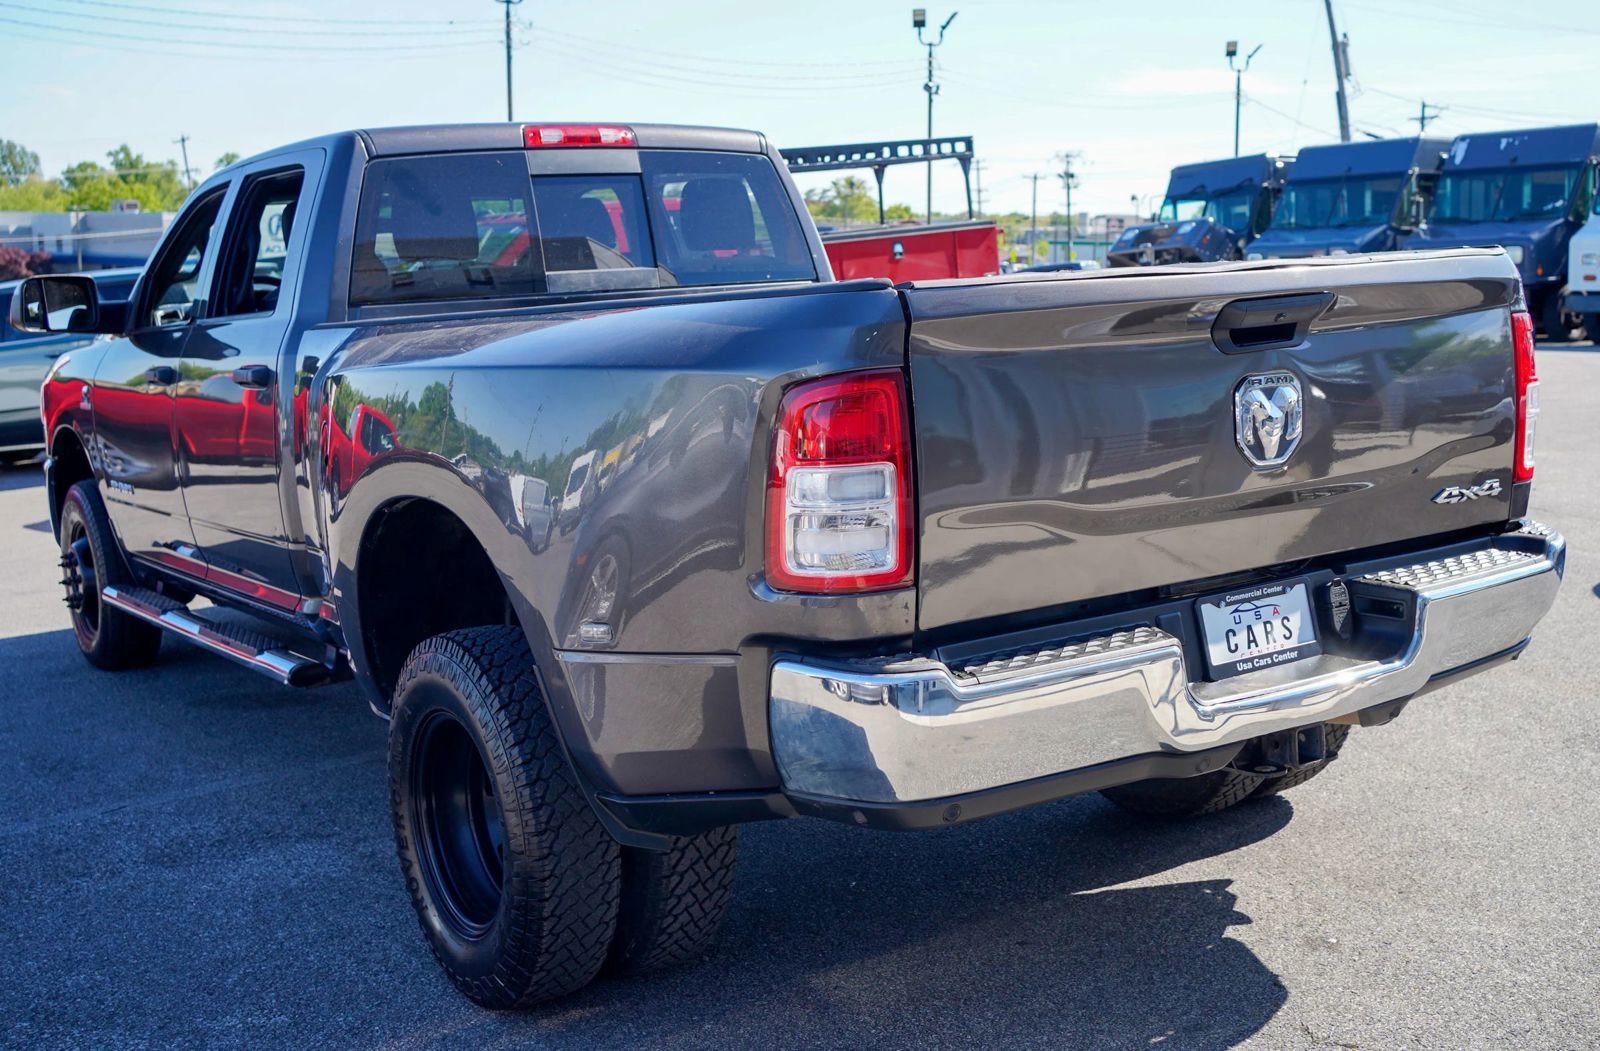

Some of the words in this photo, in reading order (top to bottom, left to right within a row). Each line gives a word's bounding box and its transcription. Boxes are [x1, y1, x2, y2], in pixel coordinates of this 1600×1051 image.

[1251, 376, 1288, 386] RAM
[1226, 589, 1262, 602] Commercial
[1263, 585, 1283, 595] Center
[1225, 615, 1293, 654] CARS
[1236, 660, 1253, 672] Usa
[1253, 655, 1272, 667] Cars
[1273, 650, 1299, 662] Center
